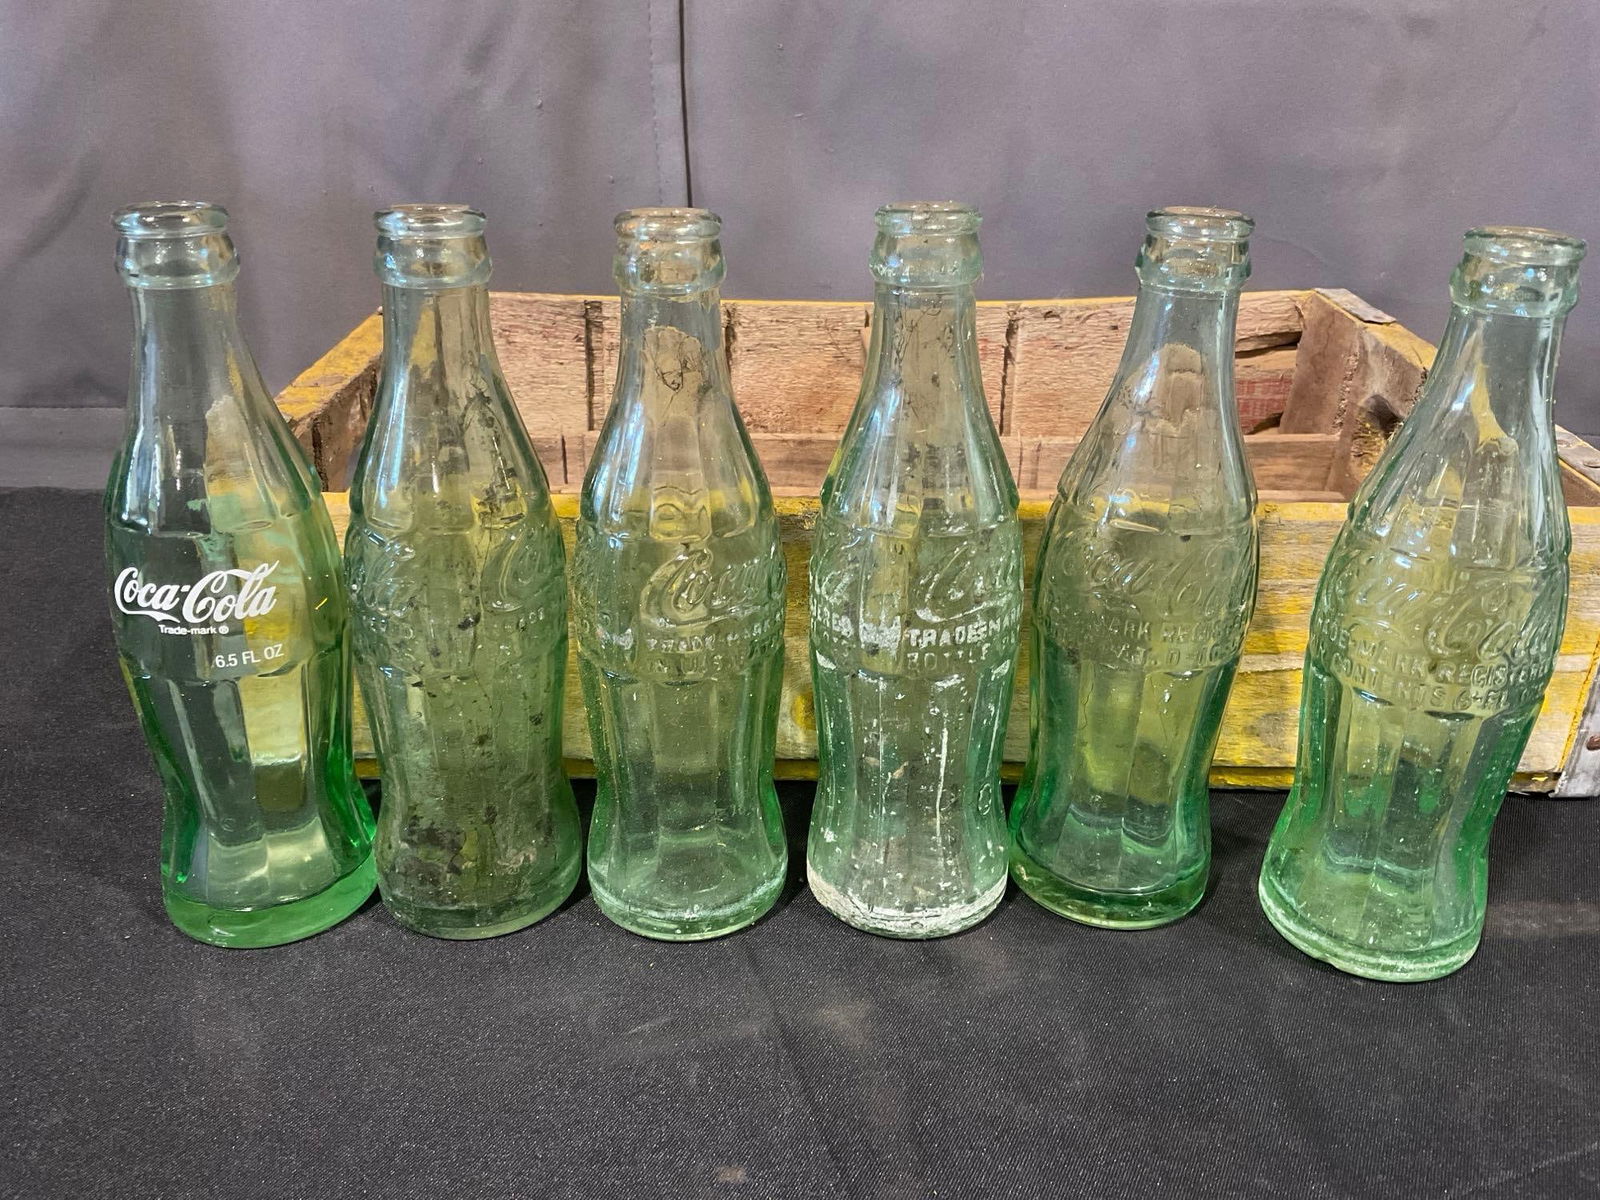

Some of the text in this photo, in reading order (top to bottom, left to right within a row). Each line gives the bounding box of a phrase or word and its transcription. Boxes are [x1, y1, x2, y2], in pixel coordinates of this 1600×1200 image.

[114, 559, 279, 623] Coca-Cola
[158, 624, 217, 635] Trade-mark
[215, 643, 285, 669] 6.5 FL OZ
